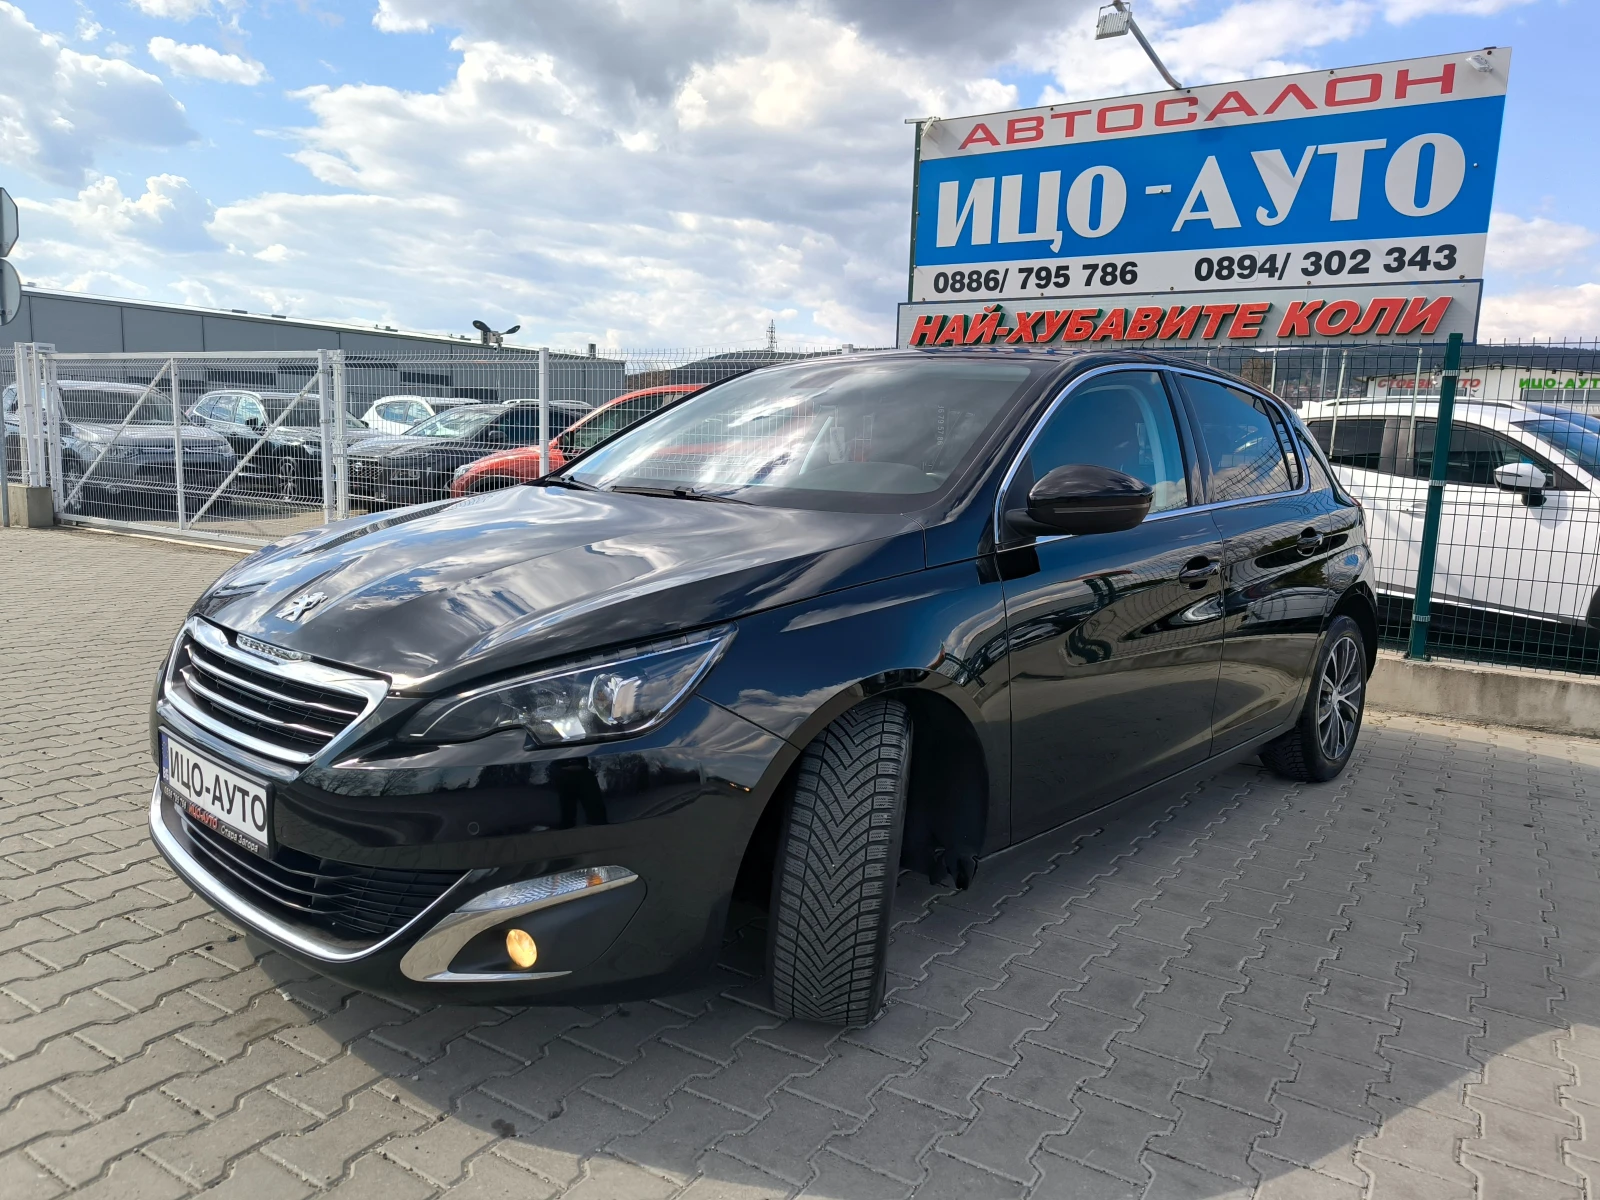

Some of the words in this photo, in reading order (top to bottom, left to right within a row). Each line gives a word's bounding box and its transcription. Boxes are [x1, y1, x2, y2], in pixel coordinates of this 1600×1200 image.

[957, 63, 1457, 150] АВТОСАЛОН
[934, 267, 1009, 293] 0886/
[1018, 265, 1070, 290] 795
[1082, 261, 1138, 286] 786
[1194, 252, 1291, 281] 0894/
[1300, 249, 1371, 277] 302
[1383, 244, 1457, 273] 343
[909, 301, 1272, 346] НАЙ-ХУБАВИТЕ
[1276, 296, 1453, 338] КОЛИ
[170, 747, 267, 833] ИЦО-АУТО
